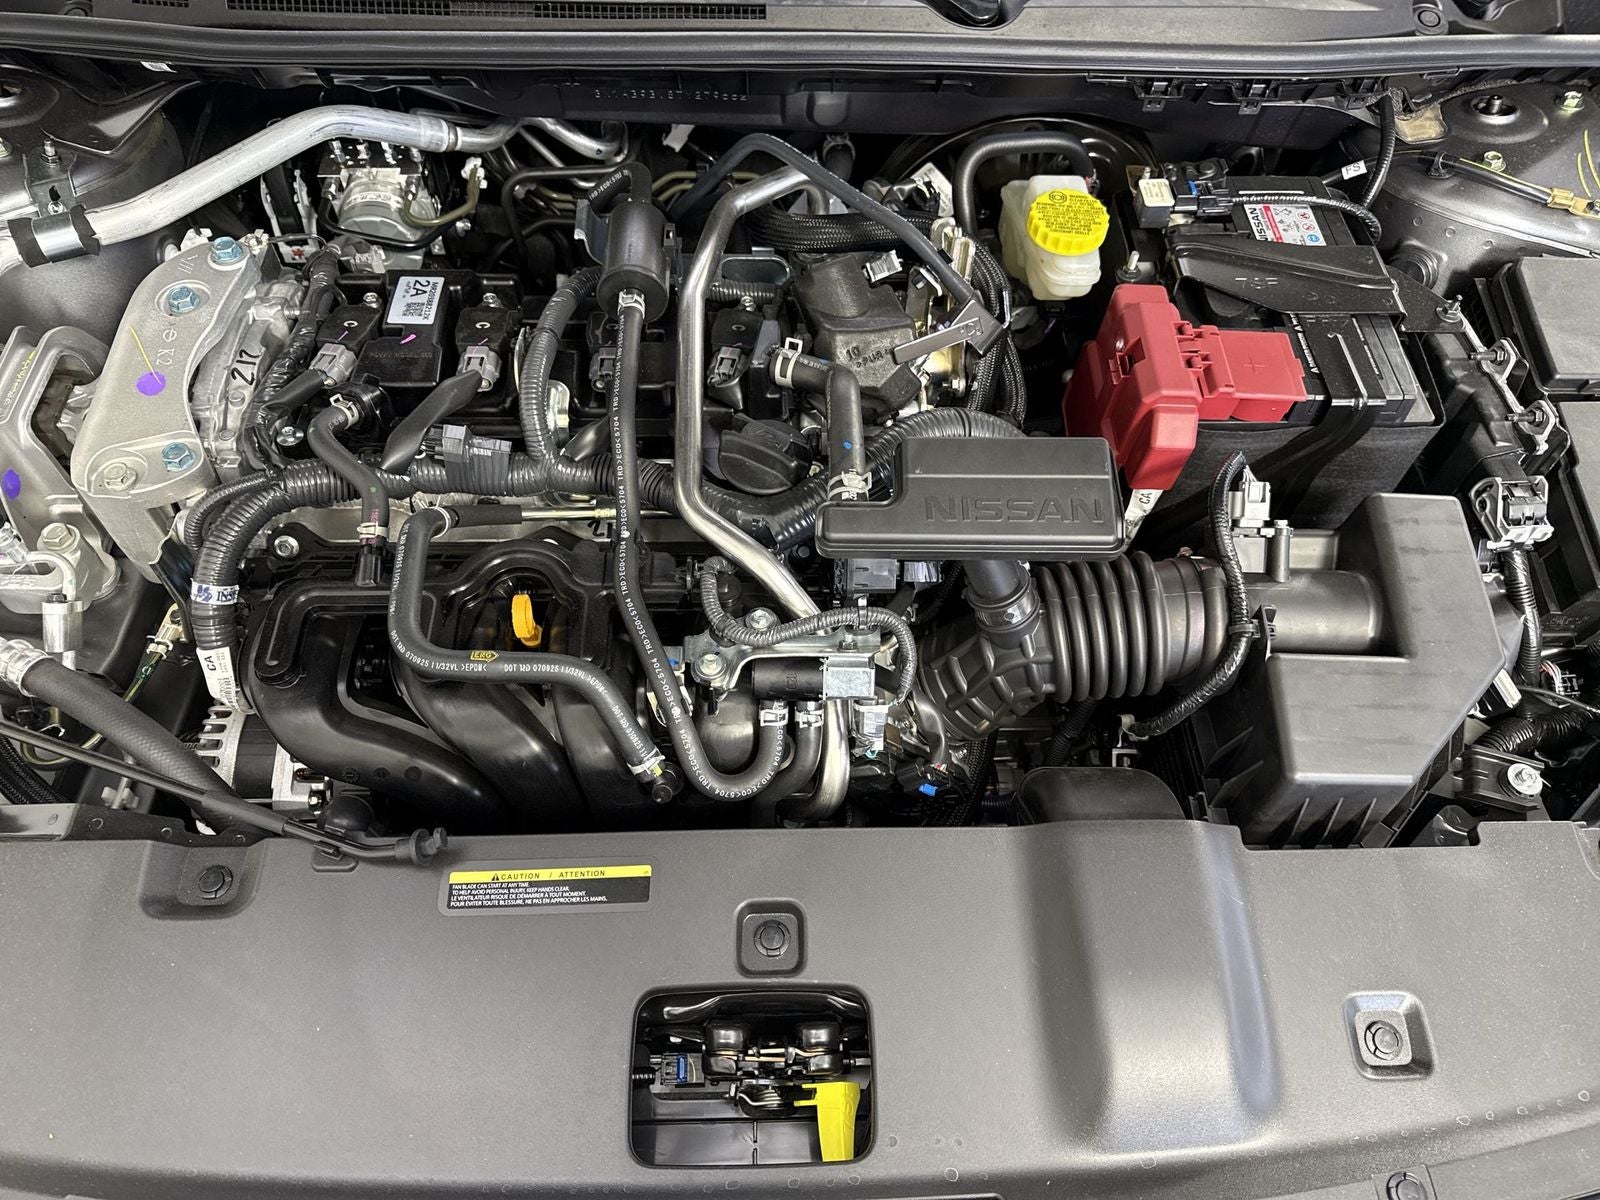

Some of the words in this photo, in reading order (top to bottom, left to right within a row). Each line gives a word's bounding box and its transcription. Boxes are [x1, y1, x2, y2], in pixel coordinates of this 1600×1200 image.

[1345, 163, 1361, 175] FS
[410, 280, 430, 297] 2A
[1139, 493, 1152, 504] CA
[923, 497, 1104, 523] NISSAN
[204, 655, 216, 671] CA
[501, 872, 540, 880] CAUTION
[558, 869, 605, 878] ATTENTION
